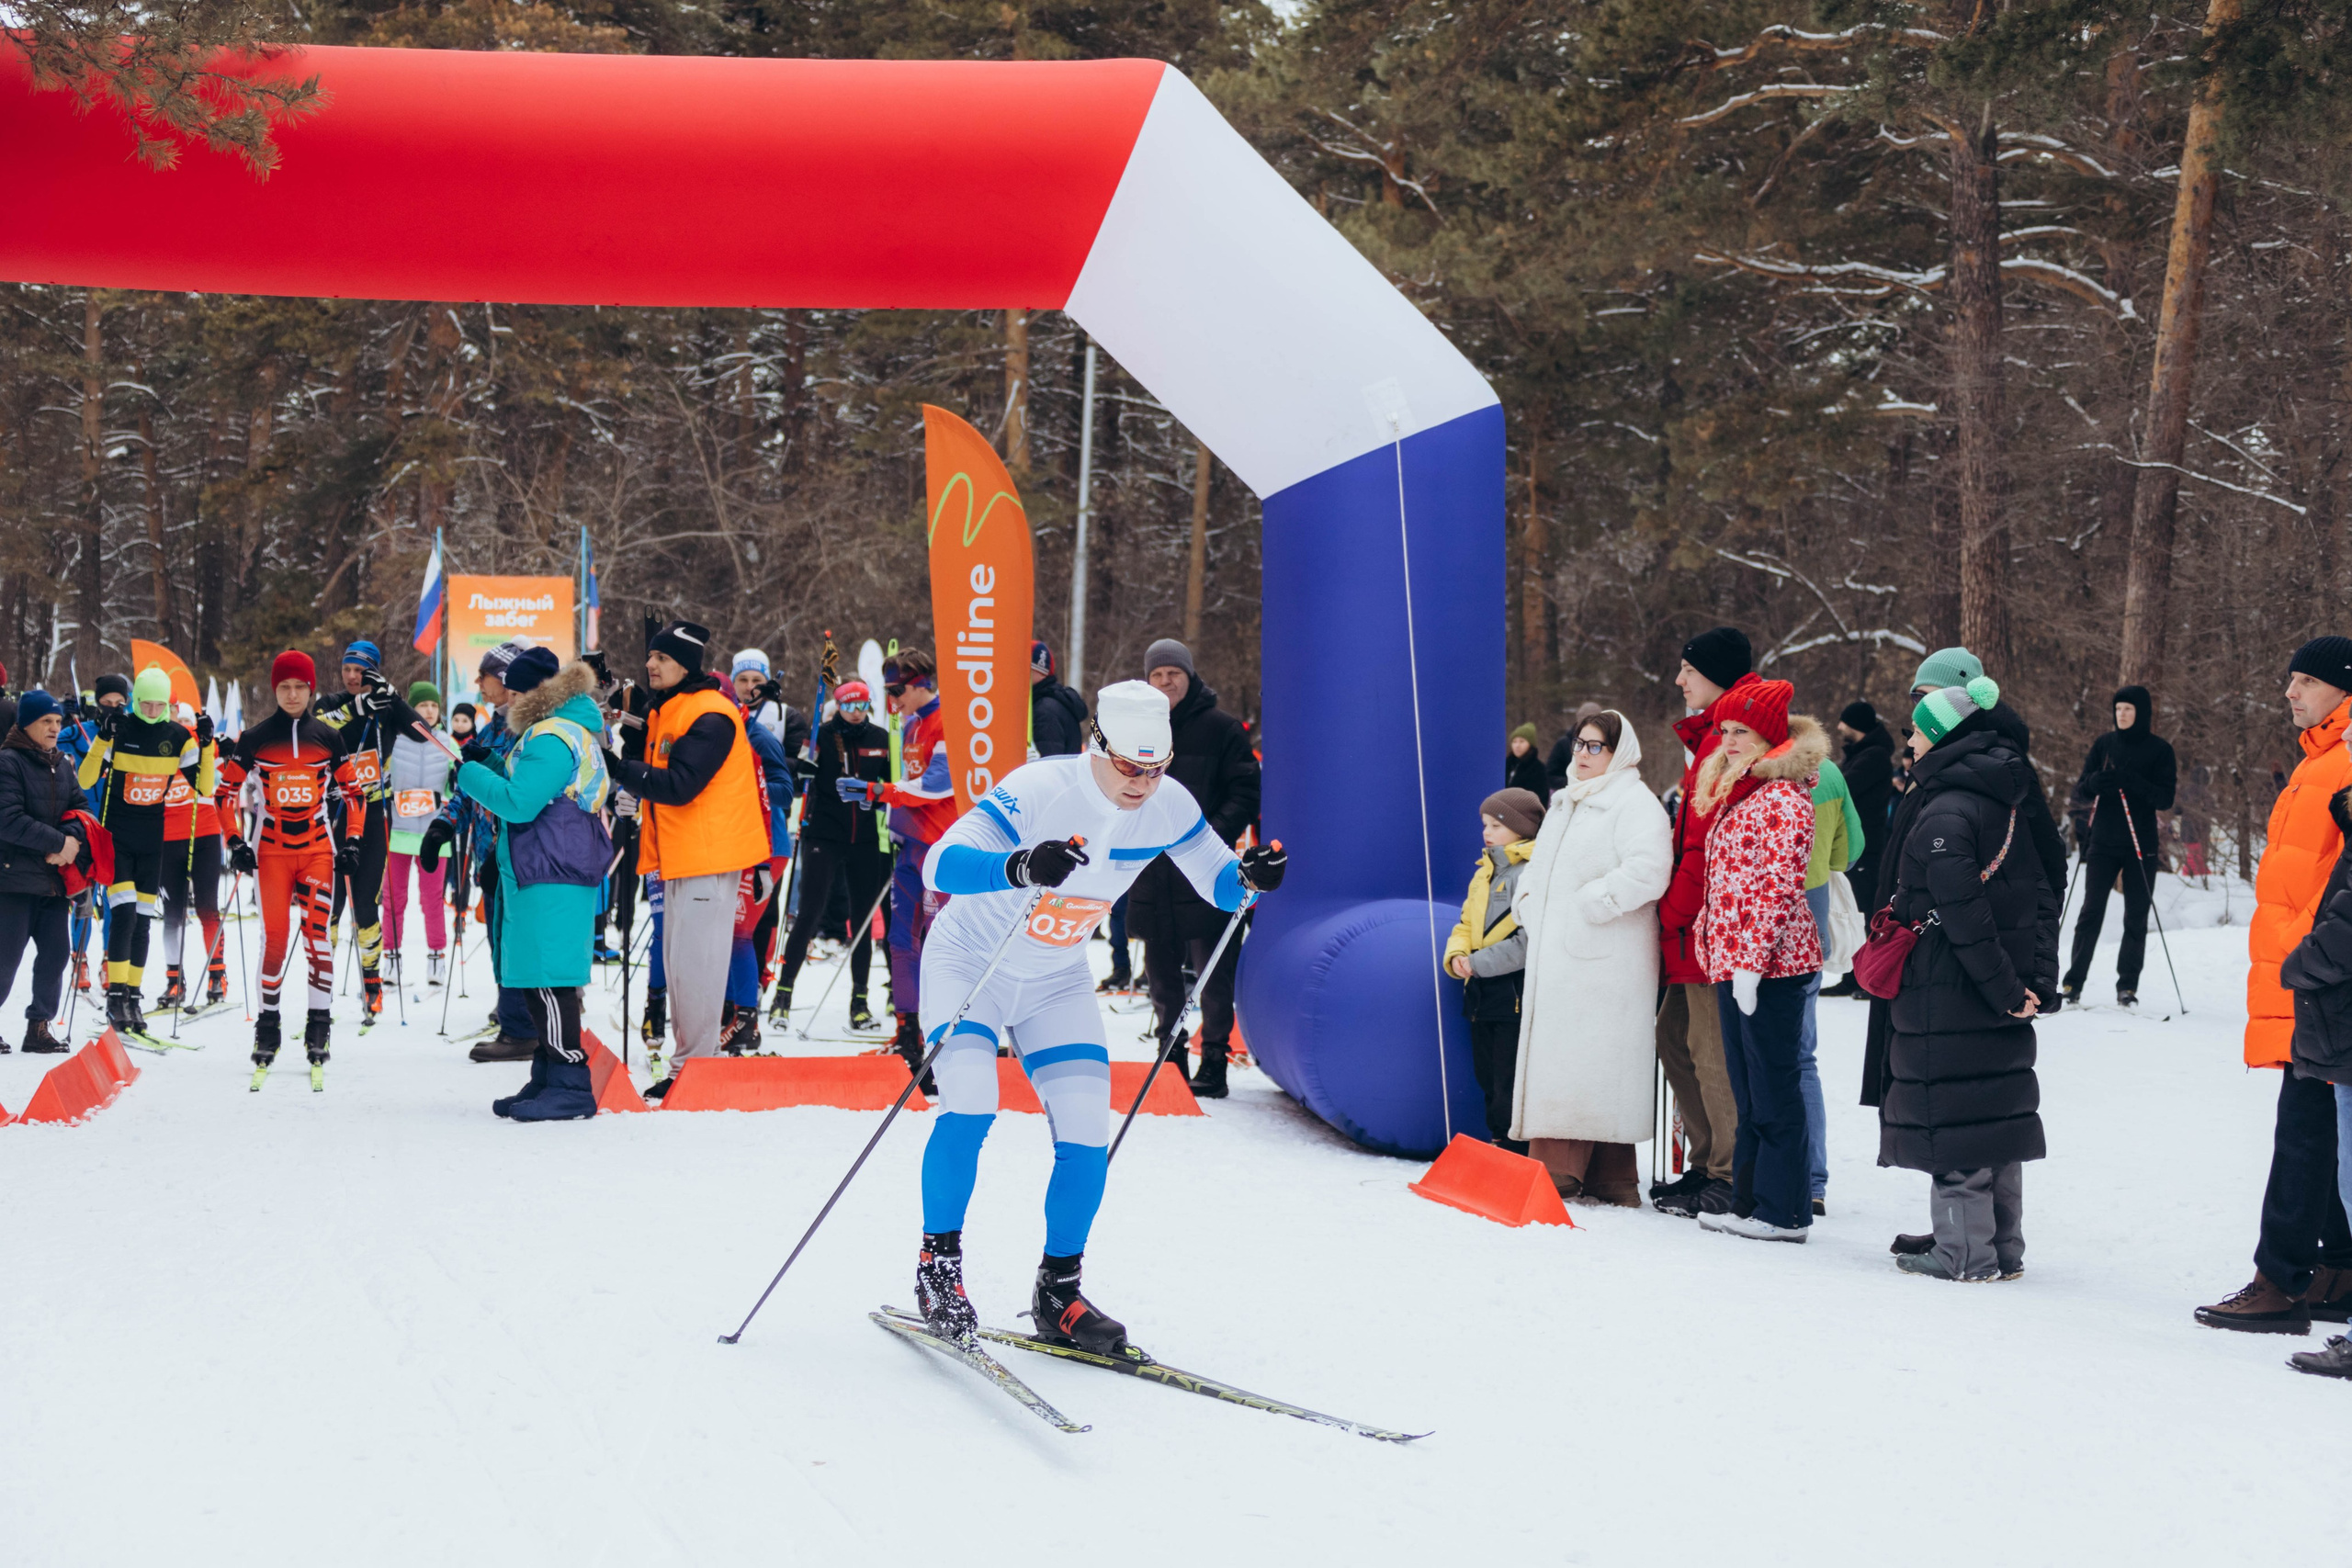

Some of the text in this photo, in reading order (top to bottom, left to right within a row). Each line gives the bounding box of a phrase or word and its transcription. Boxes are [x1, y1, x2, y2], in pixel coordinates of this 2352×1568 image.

[468, 593, 554, 611] Лыжный
[484, 610, 538, 627] забег
[956, 564, 995, 805] Goodline
[355, 765, 376, 781] 40
[130, 787, 162, 802] 036
[277, 786, 313, 803] 035
[400, 801, 430, 814] 054
[1066, 902, 1103, 911] Goodline
[1031, 913, 1091, 941] 034
